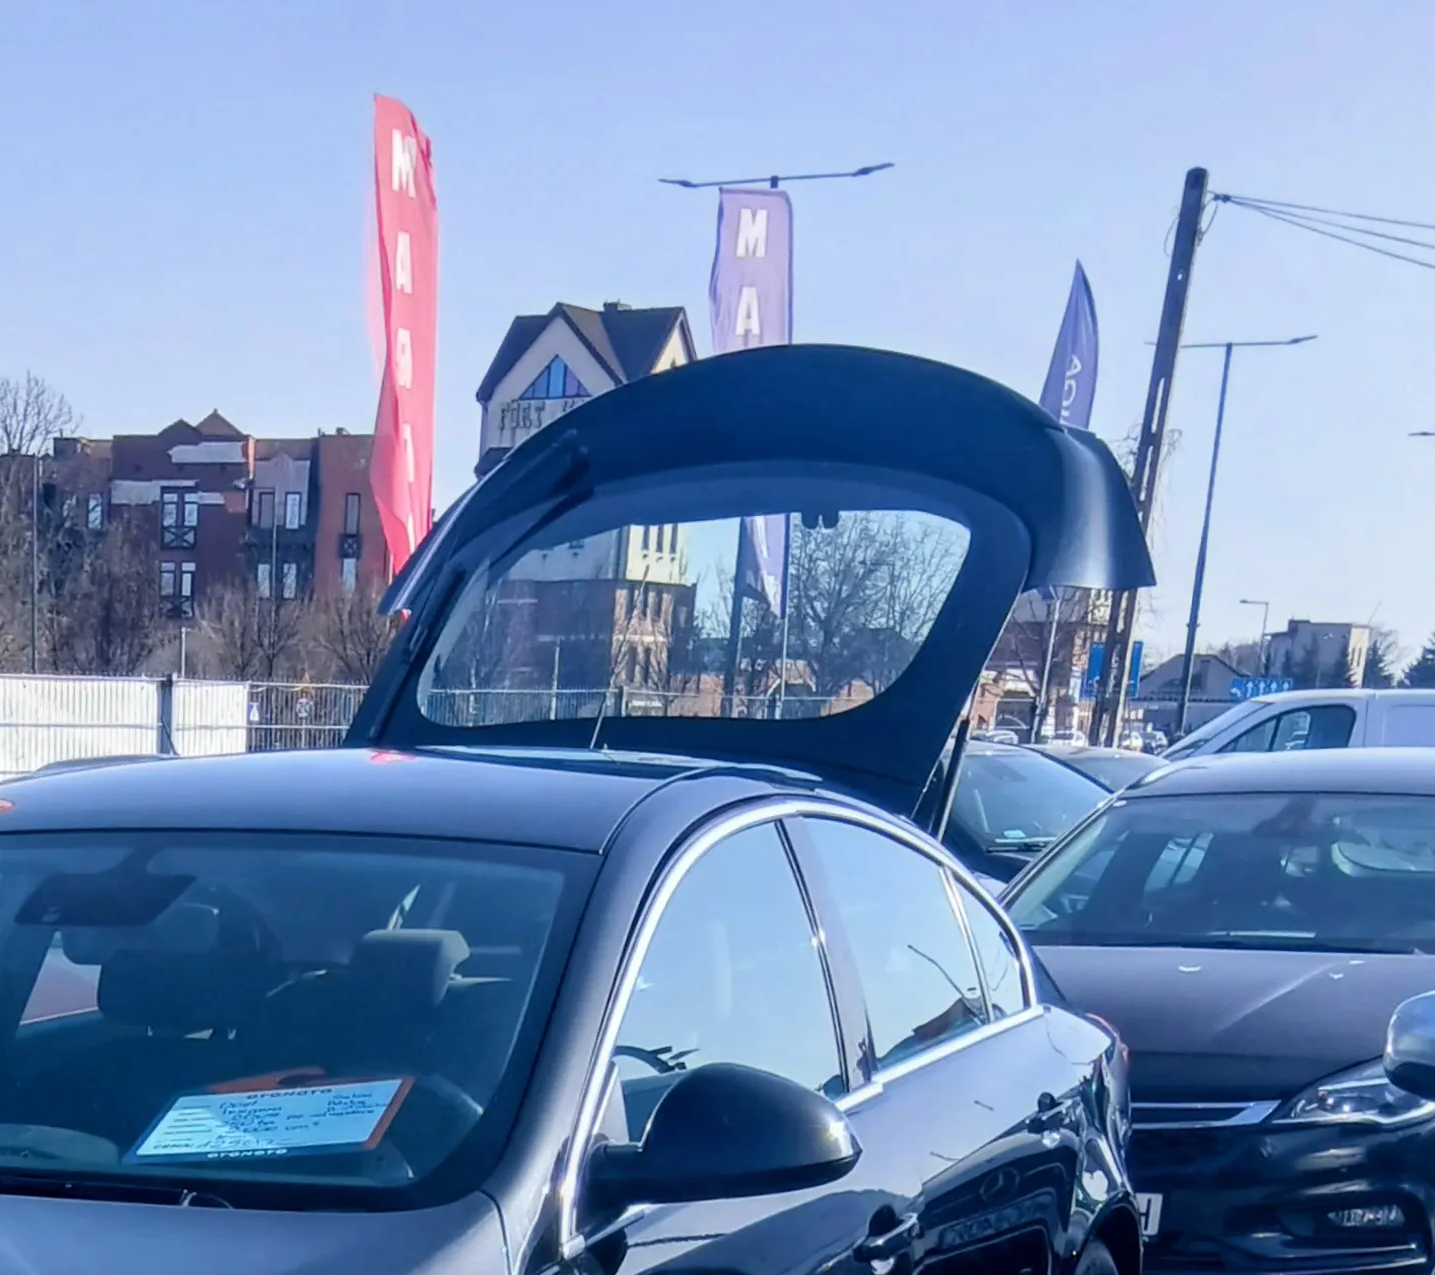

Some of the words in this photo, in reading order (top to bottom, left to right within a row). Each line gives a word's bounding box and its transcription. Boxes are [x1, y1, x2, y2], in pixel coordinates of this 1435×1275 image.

[499, 400, 545, 430] FORT
[246, 1088, 332, 1099] OTOMOTO
[207, 1148, 287, 1158] OTOMOTO
